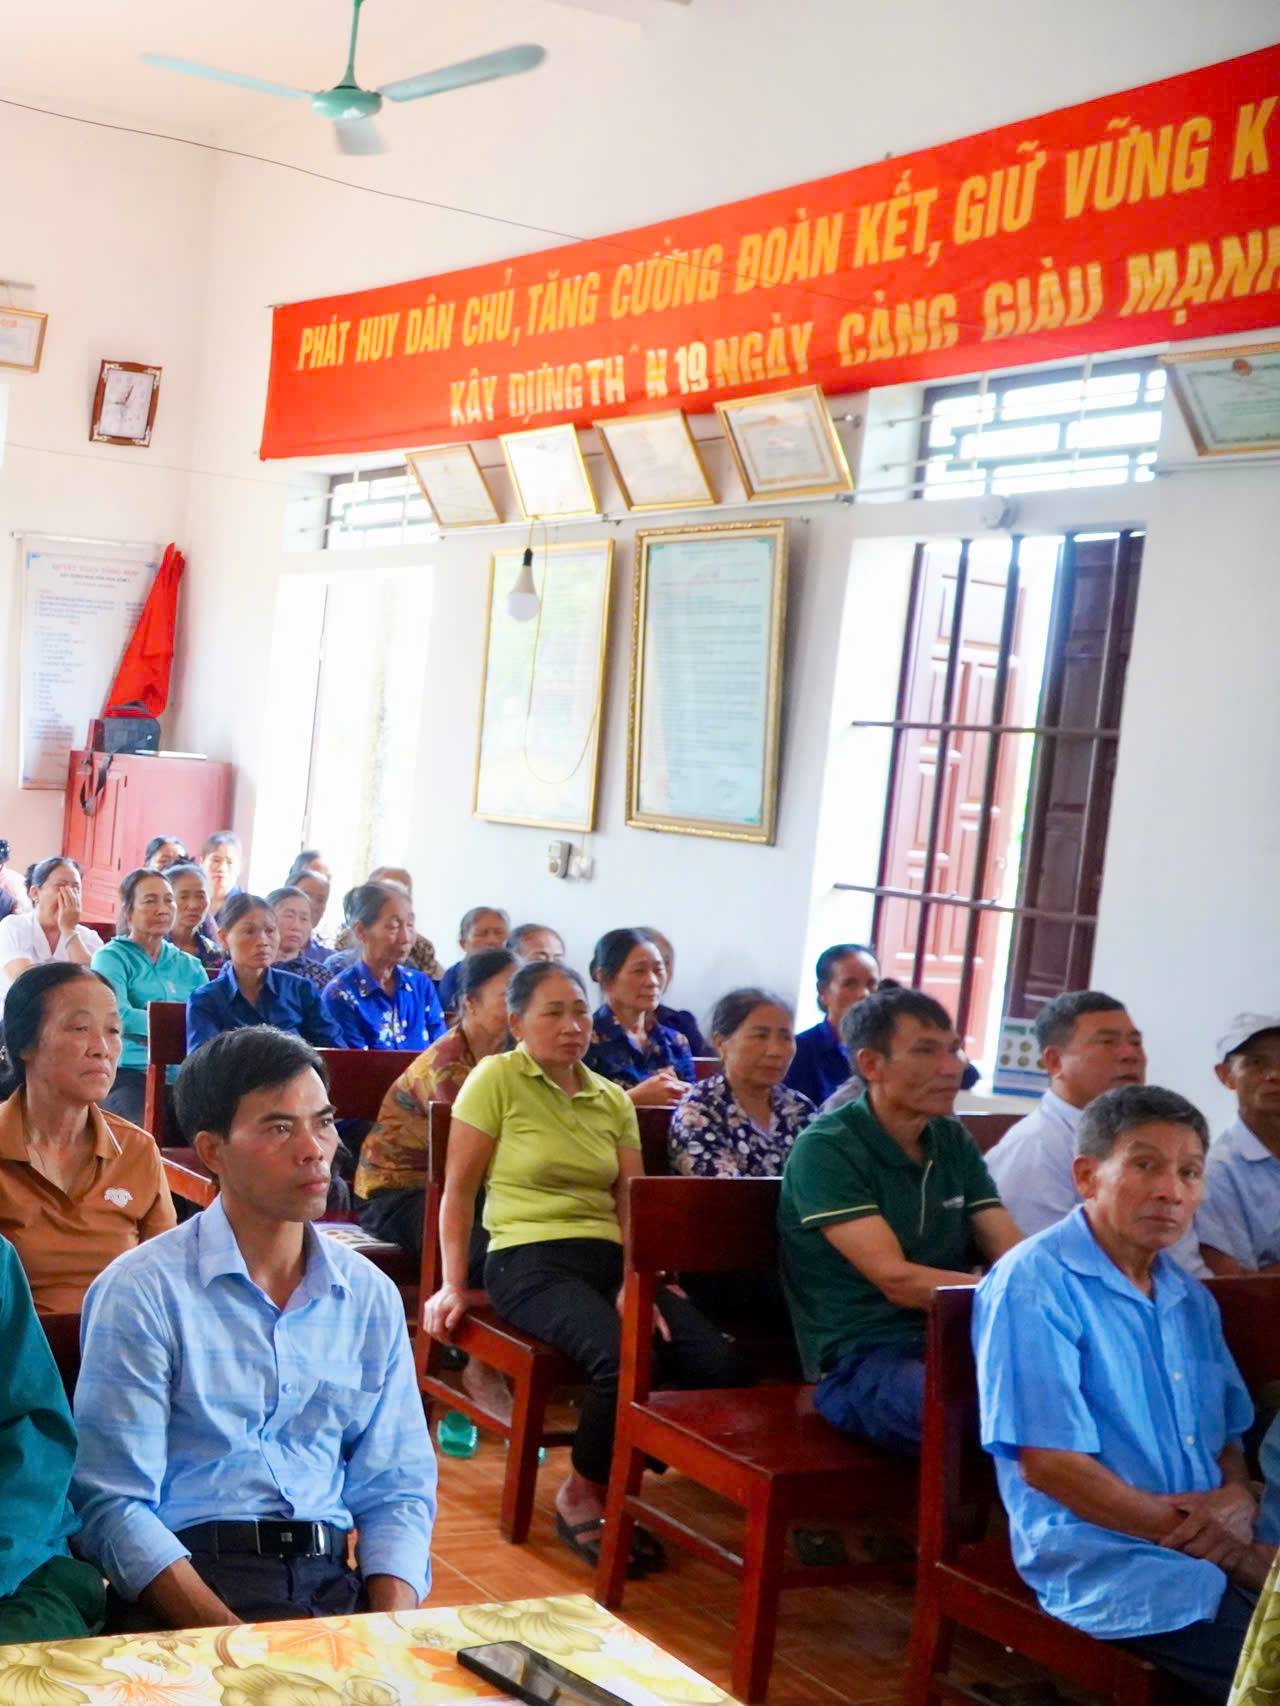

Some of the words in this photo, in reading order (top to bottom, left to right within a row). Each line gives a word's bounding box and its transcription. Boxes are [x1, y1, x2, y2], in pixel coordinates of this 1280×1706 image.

[297, 314, 351, 371] PHÁT
[355, 313, 400, 363] HUY
[404, 293, 455, 356] DÂN
[527, 269, 600, 336] TĂNG
[611, 236, 724, 320] CƯỜNG
[735, 208, 844, 295] ĐOÀN
[954, 140, 1048, 245] GIỮ
[1064, 115, 1213, 220] VỮNG
[508, 362, 583, 424] DỰNG
[674, 341, 710, 395] 19
[713, 311, 814, 388] NGÀY
[836, 289, 959, 367] CÀNG
[982, 255, 1103, 342] GIÀU
